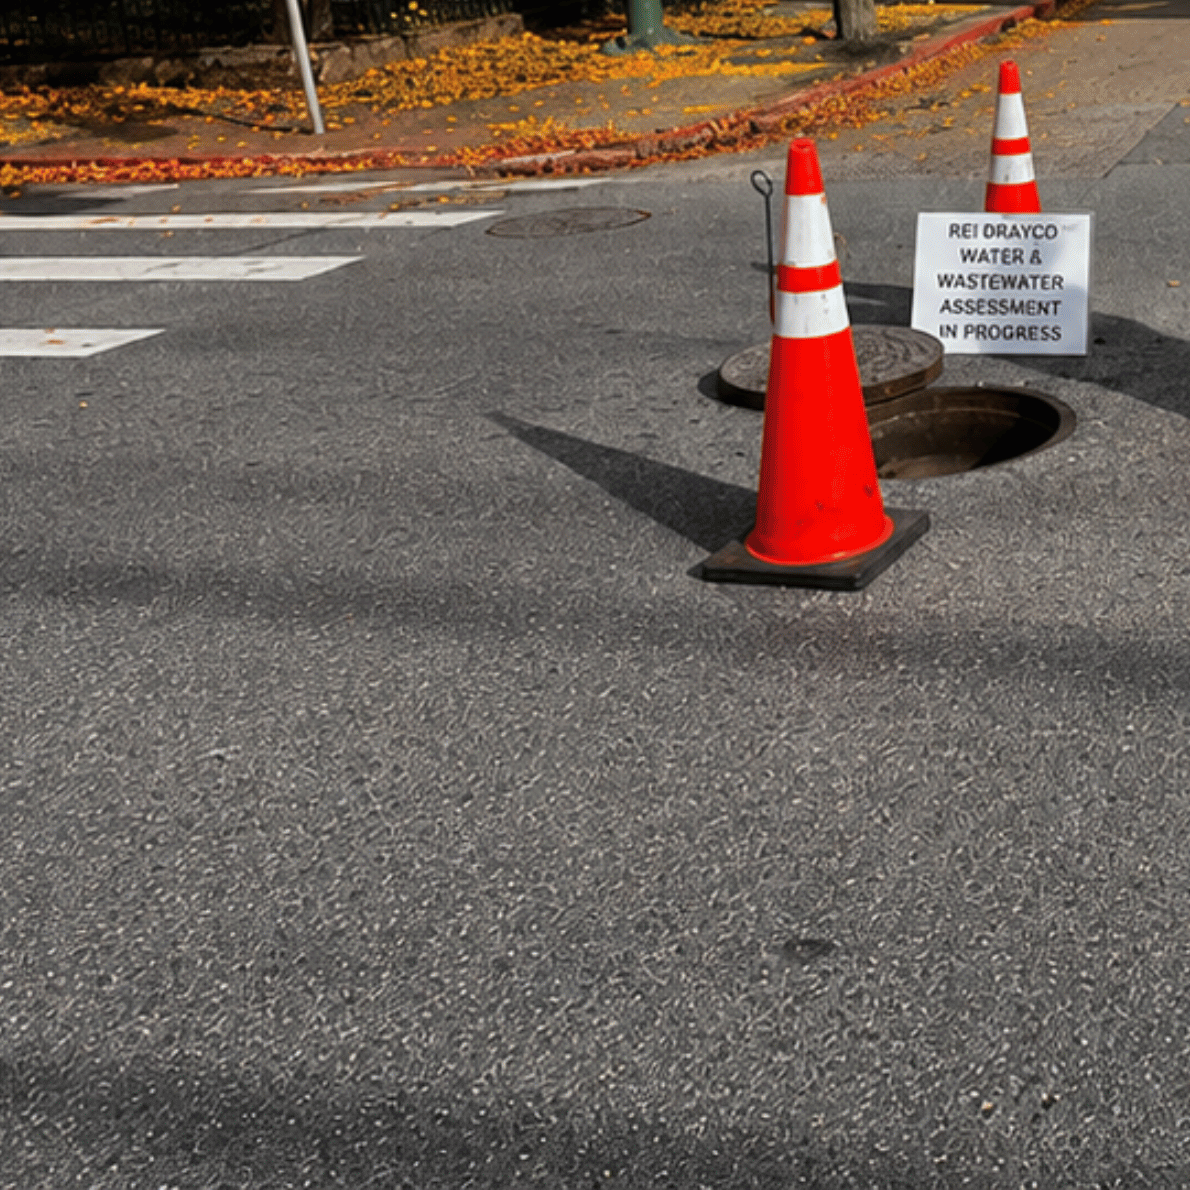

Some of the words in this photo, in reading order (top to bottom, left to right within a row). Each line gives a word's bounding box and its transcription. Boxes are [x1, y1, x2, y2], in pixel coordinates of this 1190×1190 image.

[948, 223, 978, 239] REI
[983, 223, 1058, 240] DRAYCO
[960, 247, 1024, 266] WATER
[937, 273, 1064, 291] WASTEWATER
[939, 298, 1062, 316] ASSESSMENT
[938, 324, 958, 339] IN
[963, 324, 1063, 341] PROGRESS
